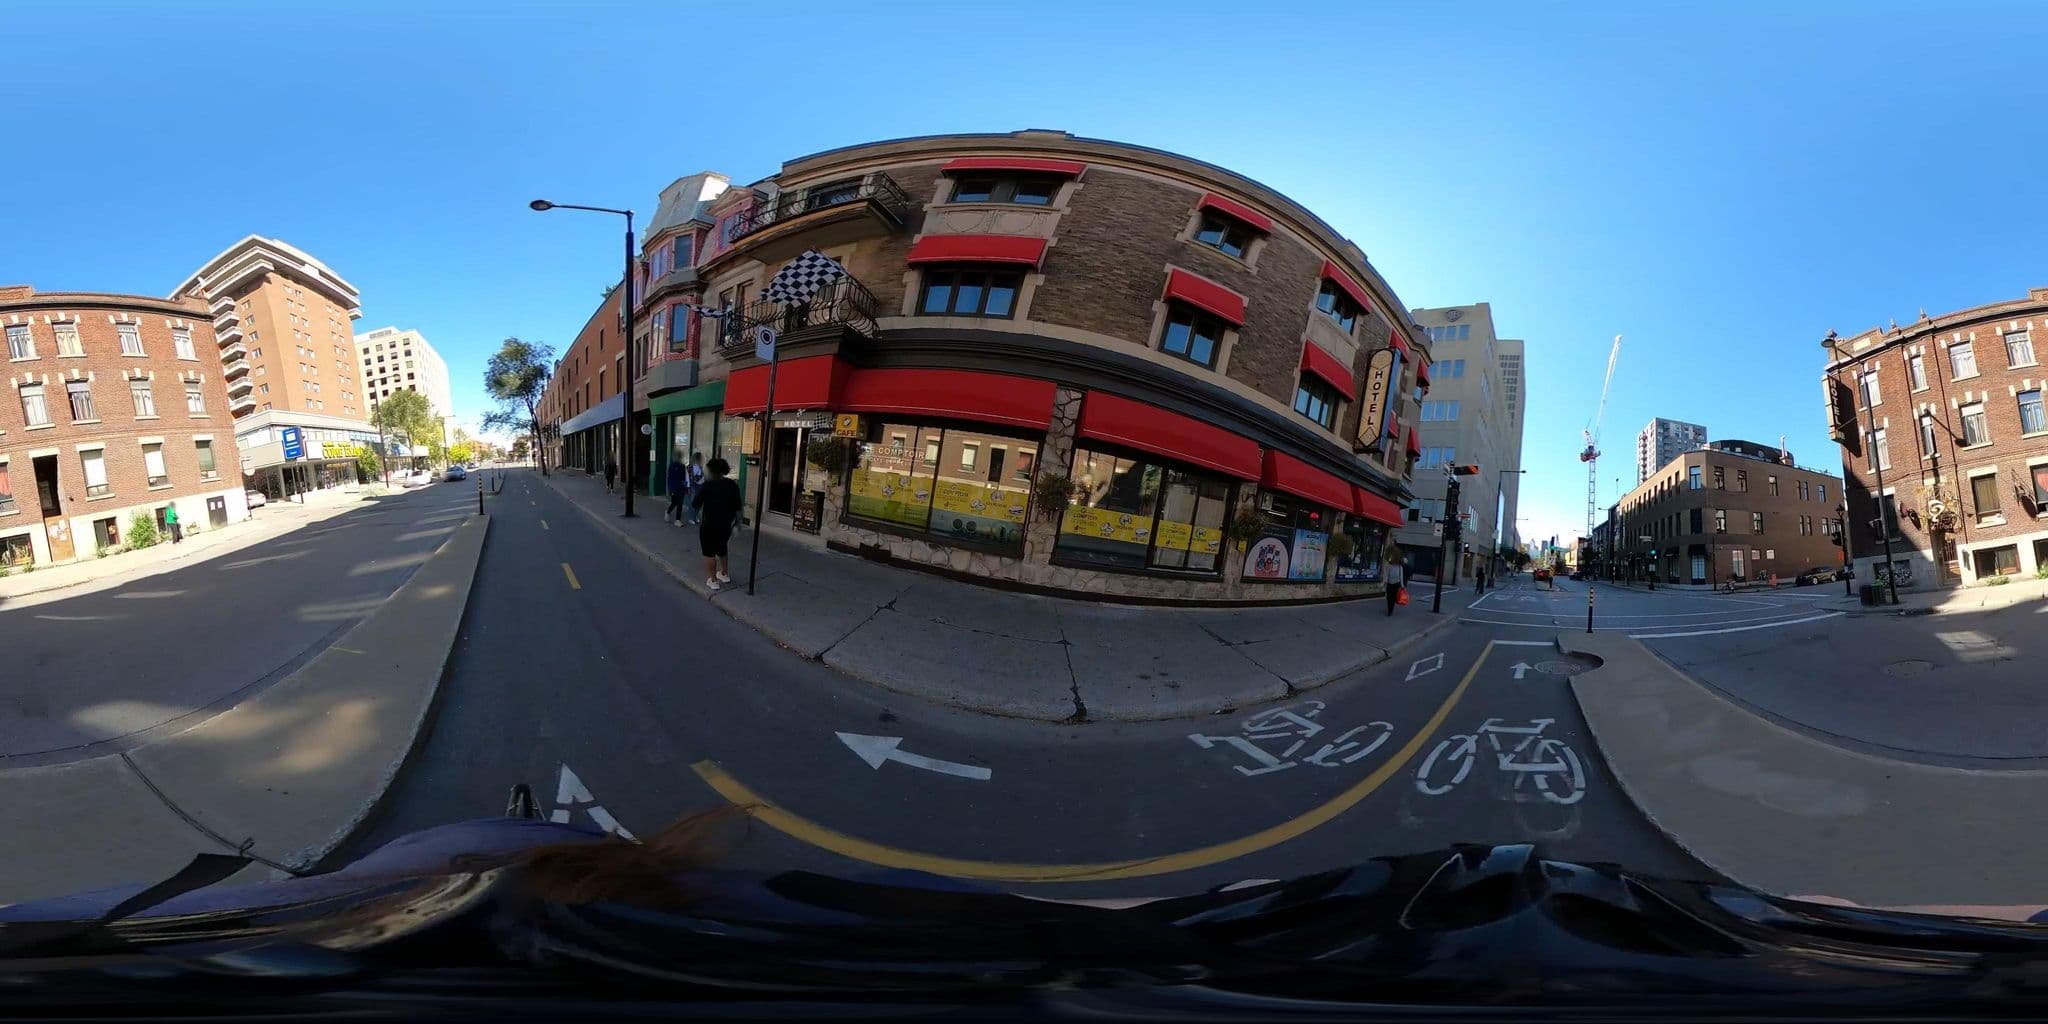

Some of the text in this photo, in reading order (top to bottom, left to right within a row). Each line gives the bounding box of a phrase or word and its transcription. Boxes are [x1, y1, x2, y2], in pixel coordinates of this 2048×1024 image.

[1368, 371, 1383, 426] HOTEL
[1830, 379, 1842, 426] HOTEL
[784, 420, 811, 428] HOTEL
[878, 447, 925, 459] COMPTOIR
